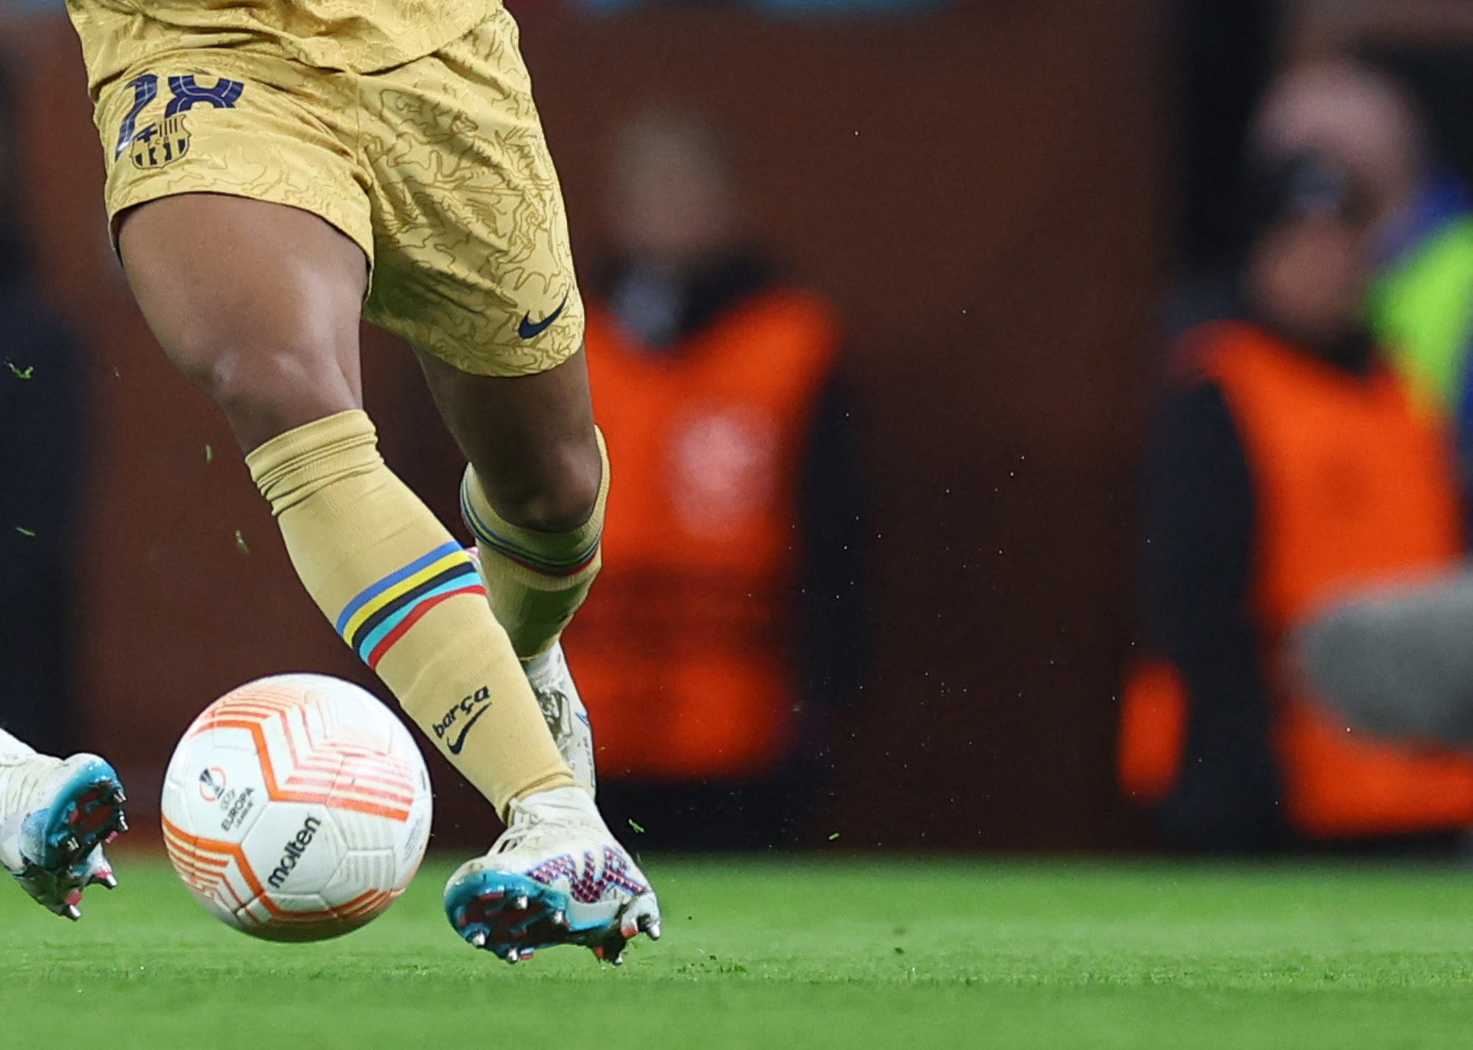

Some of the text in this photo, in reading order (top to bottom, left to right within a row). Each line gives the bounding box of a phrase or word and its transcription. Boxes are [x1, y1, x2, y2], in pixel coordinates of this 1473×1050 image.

[432, 685, 490, 739] barça
[220, 787, 255, 832] EUROPA
[267, 815, 322, 889] molten
